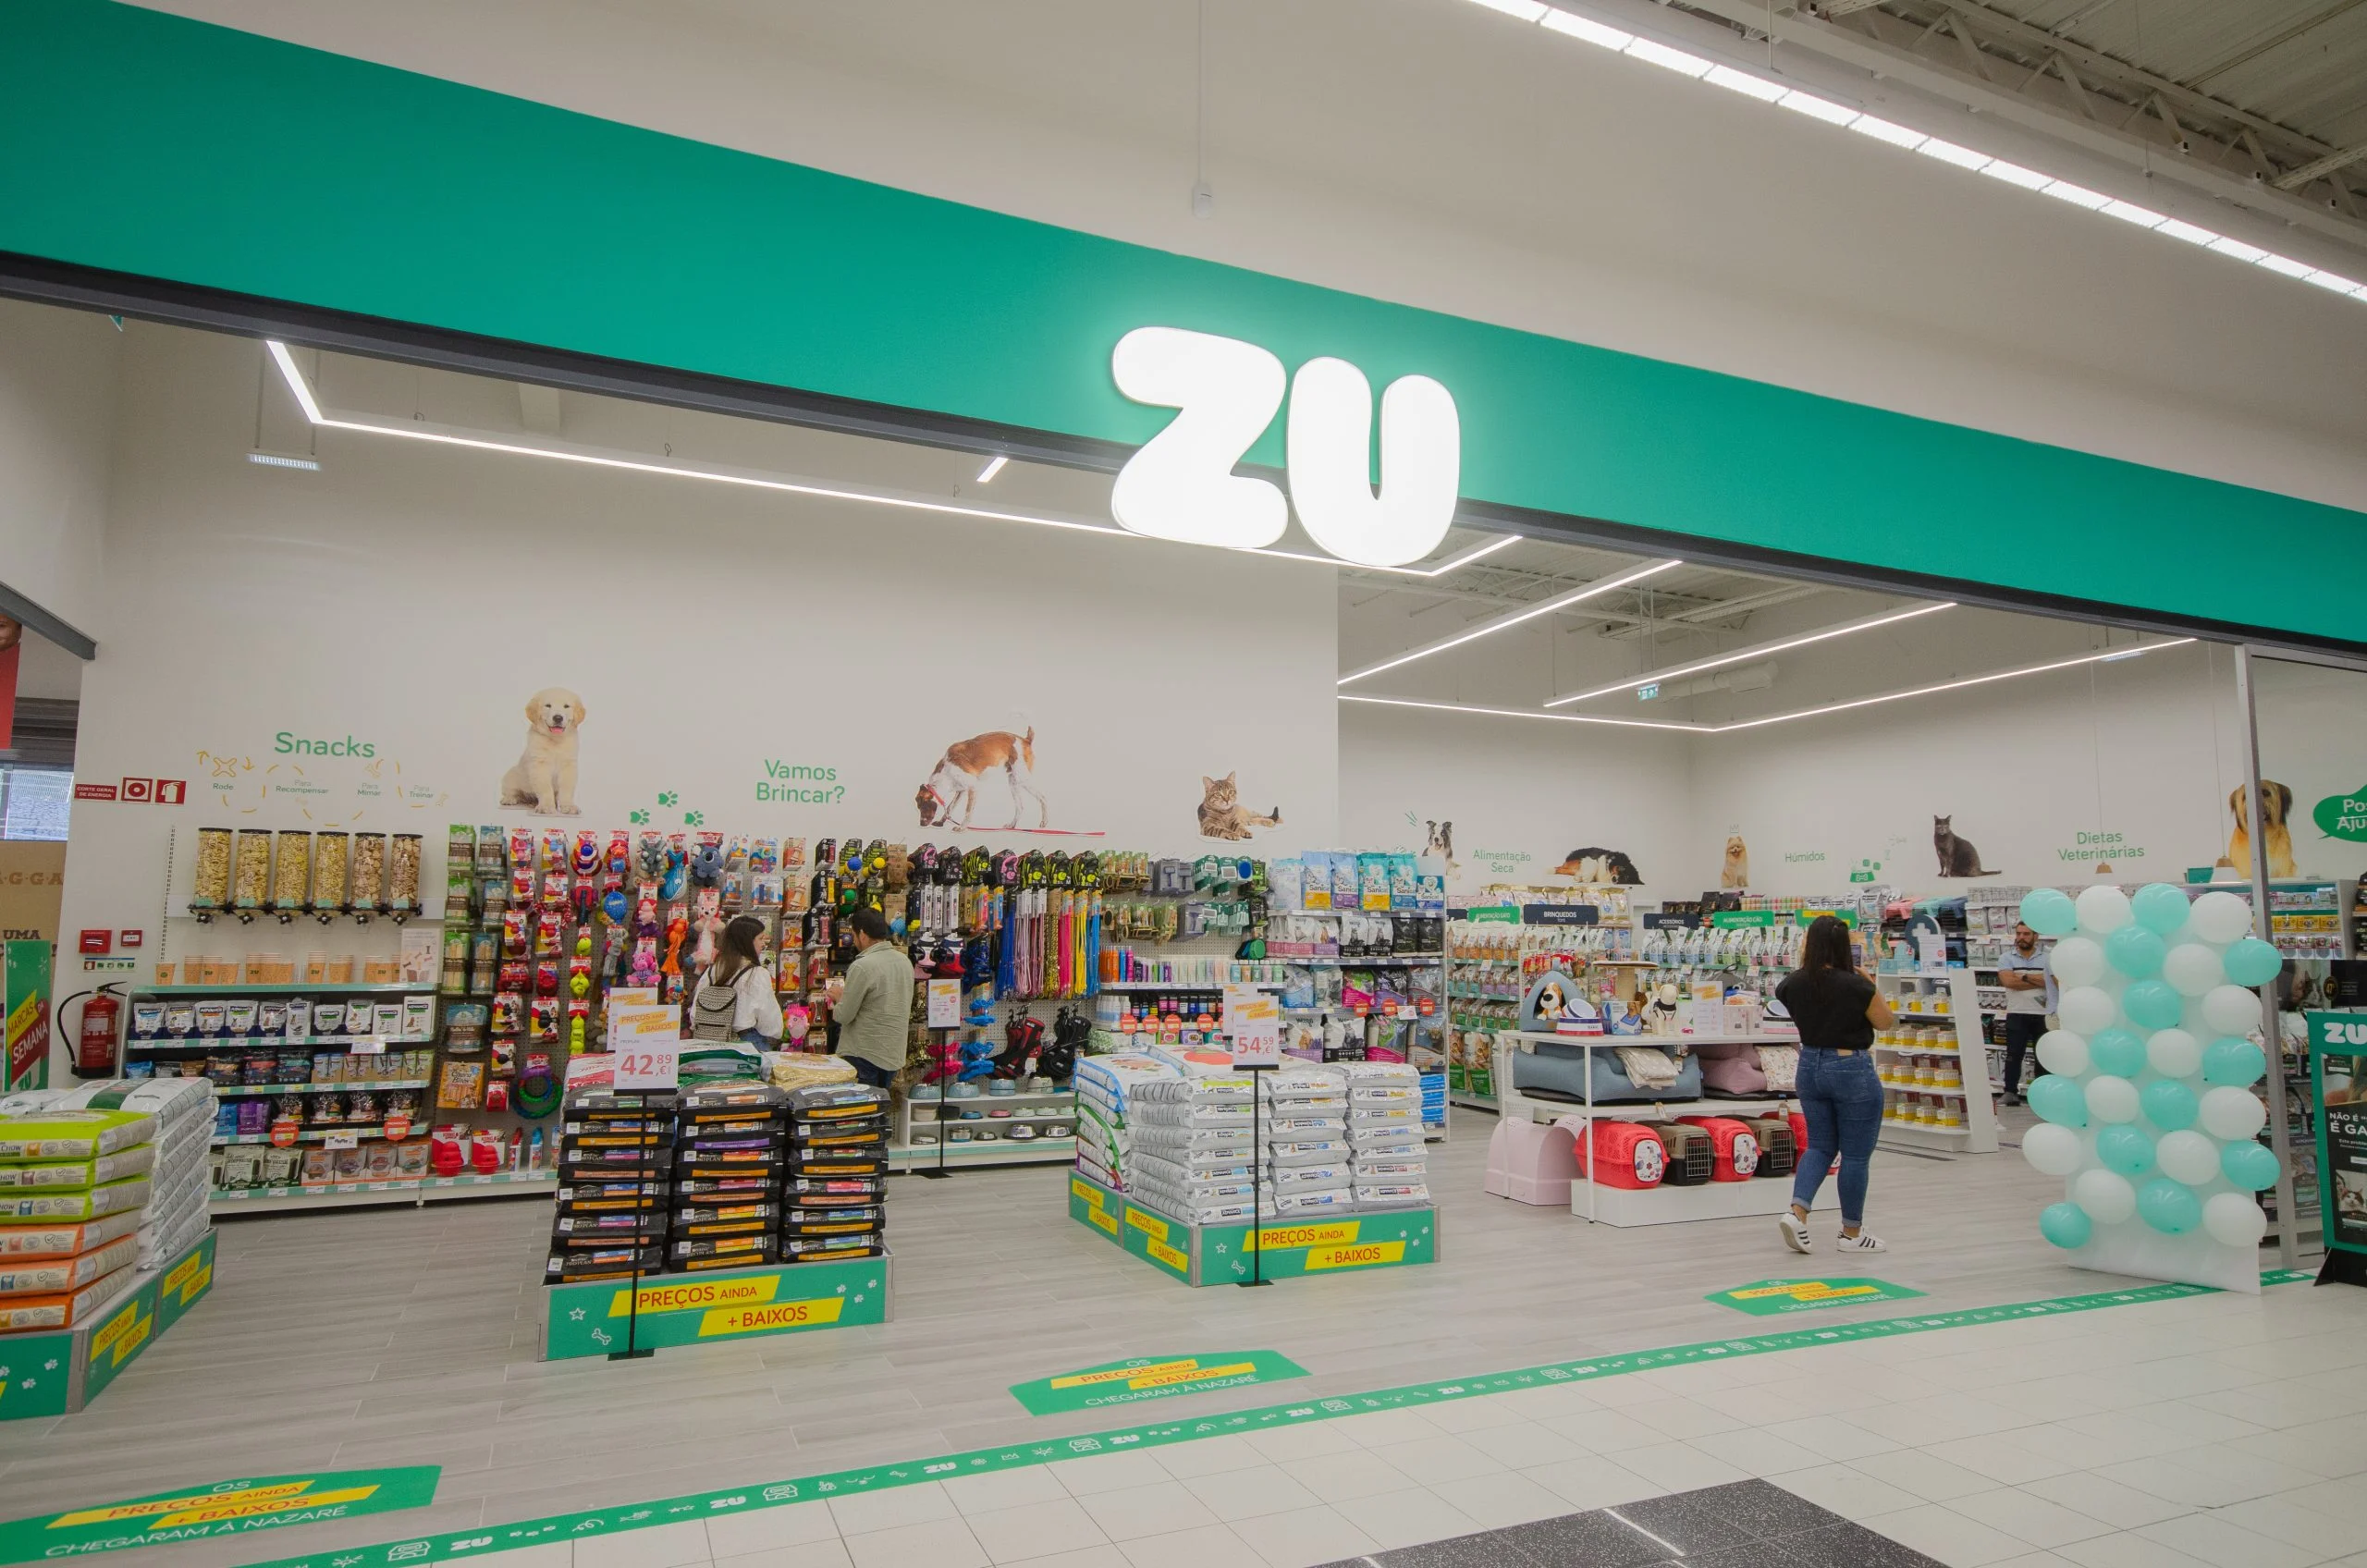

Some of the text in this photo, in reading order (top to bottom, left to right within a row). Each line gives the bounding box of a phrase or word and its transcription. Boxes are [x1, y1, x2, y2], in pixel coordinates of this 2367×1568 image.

[1111, 326, 1461, 567] ZU
[275, 731, 375, 758] Snacks
[765, 758, 837, 781] Vamos
[276, 786, 329, 794] Recompensar
[756, 781, 845, 804] Brincar?
[2343, 799, 2367, 813] Po
[2336, 816, 2367, 832] Aju
[2077, 831, 2122, 844] Dietas
[1473, 850, 1531, 863] Alimentação
[1784, 850, 1825, 863] Húmidos
[2057, 845, 2145, 861] Veterinárias
[1490, 863, 1514, 873] Seca
[1723, 915, 1752, 924] ALIMENTAÇÃO
[3, 929, 40, 940] UMA
[8, 1000, 35, 1035] MARCAS
[621, 1013, 651, 1023] PREÇOS
[645, 1023, 672, 1032] BAIXOS
[2324, 1022, 2367, 1045] ZU
[12, 1021, 48, 1065] SEMANA
[2329, 1111, 2350, 1121] NÃO
[2352, 1113, 2359, 1122] É
[2330, 1120, 2340, 1133] É
[1, 1145, 22, 1153] CHOW
[1076, 1182, 1092, 1198] PREÇOS
[1131, 1211, 1151, 1231] PREÇOS
[1262, 1228, 1345, 1245] PREÇOS AINDA
[1158, 1244, 1177, 1265] BAIXOS
[1334, 1247, 1380, 1264] BAIXOS
[638, 1285, 757, 1309] PREÇOS AINDA
[742, 1305, 808, 1328] BAIXOS
[99, 1317, 121, 1350] PREÇOS
[125, 1327, 142, 1354] BAIXOS
[1126, 1358, 1150, 1367] OS
[1080, 1366, 1155, 1383] PREÇOS
[1152, 1369, 1219, 1385] BAIXOS
[1085, 1375, 1260, 1406] CHEGARAM À NAZARÉ
[1110, 1434, 1140, 1445] ZU
[924, 1462, 956, 1474] ZU
[213, 1481, 251, 1493] OS
[106, 1486, 301, 1519] PREÇOS AINDA
[195, 1498, 312, 1522] BAIXOS
[710, 1496, 746, 1509] ZU
[44, 1504, 350, 1559] CHEGARAM À NAZARÉ
[451, 1536, 493, 1551] ZU
